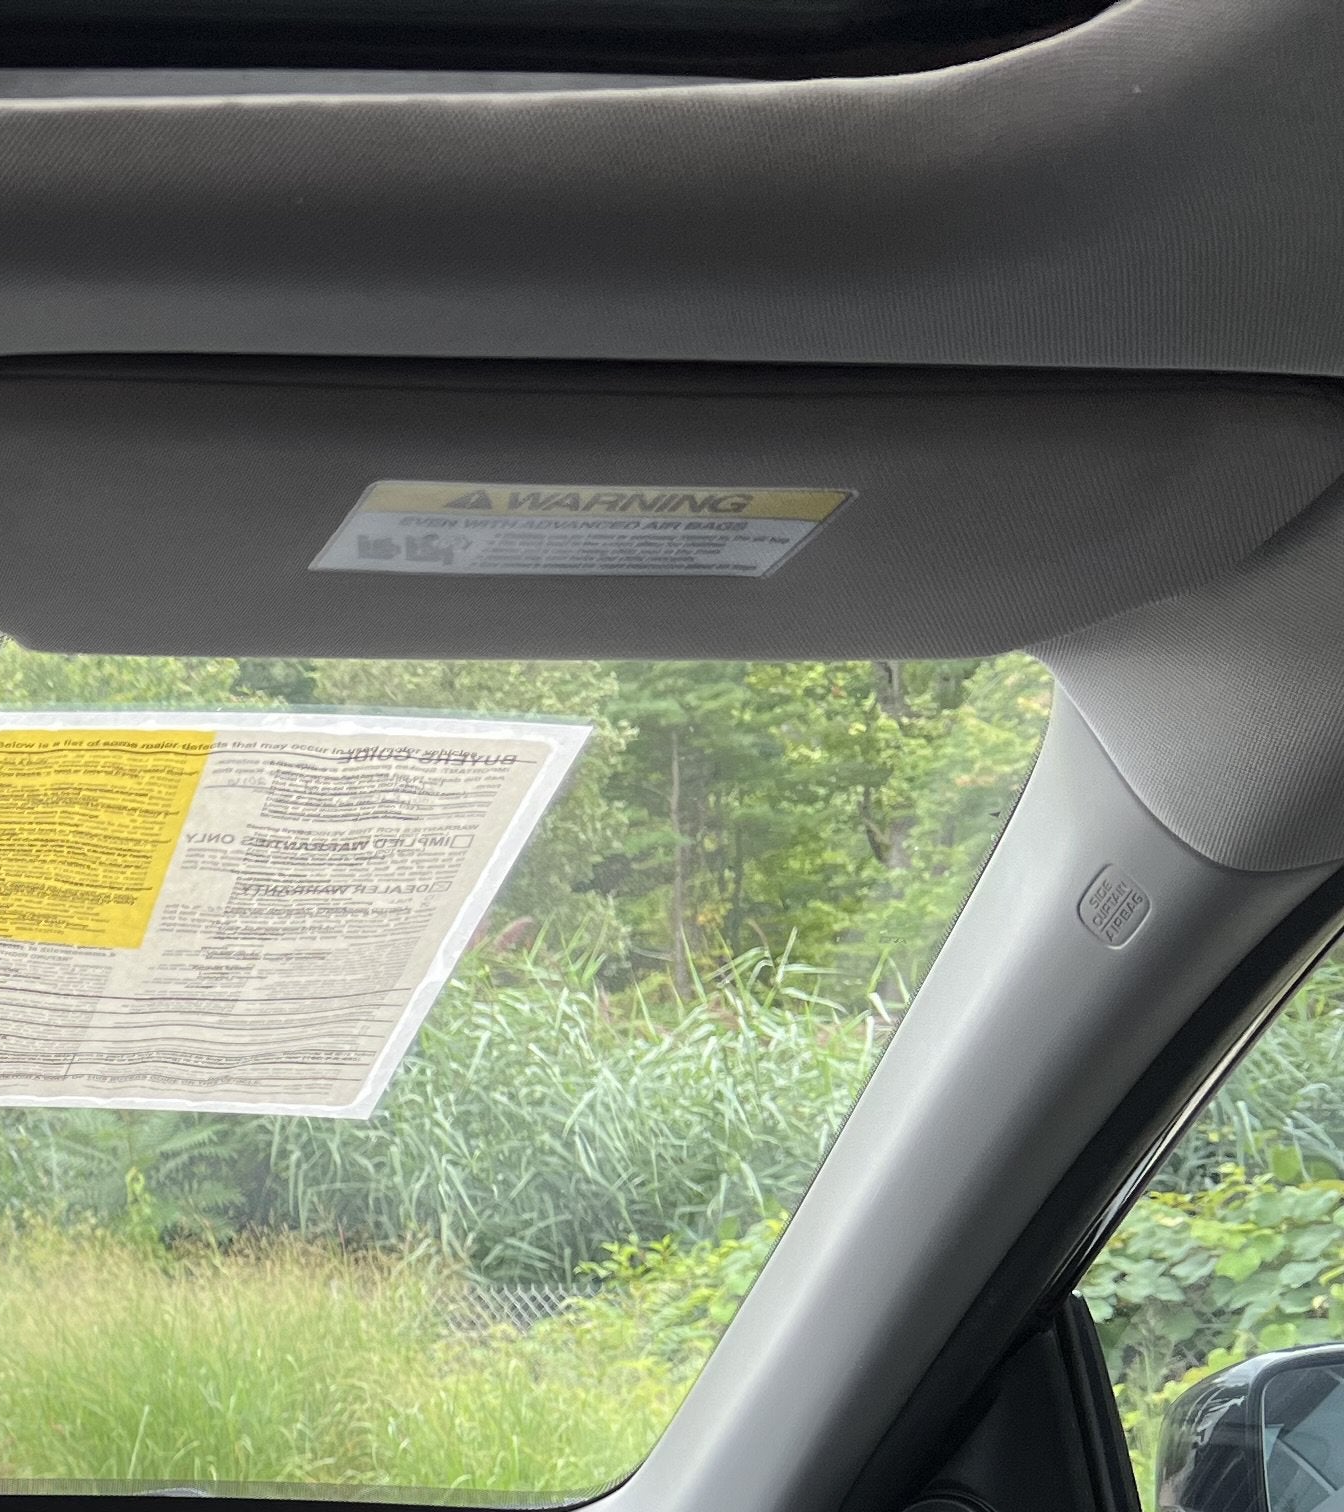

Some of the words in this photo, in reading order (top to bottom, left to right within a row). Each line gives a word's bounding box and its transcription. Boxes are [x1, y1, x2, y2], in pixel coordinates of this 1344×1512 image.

[507, 491, 753, 513] WARNING
[398, 516, 459, 528] EVEN
[463, 517, 517, 529] WITH
[520, 518, 642, 531] ADVANCED
[643, 520, 682, 531] AIR
[684, 520, 748, 531] BAGS
[64, 739, 84, 747] list
[87, 739, 100, 747] of
[102, 741, 138, 749] some
[141, 740, 179, 750] major
[231, 741, 257, 749] that
[261, 742, 288, 750] may
[290, 743, 329, 755] occur
[1105, 892, 1144, 943] AIRBAG
